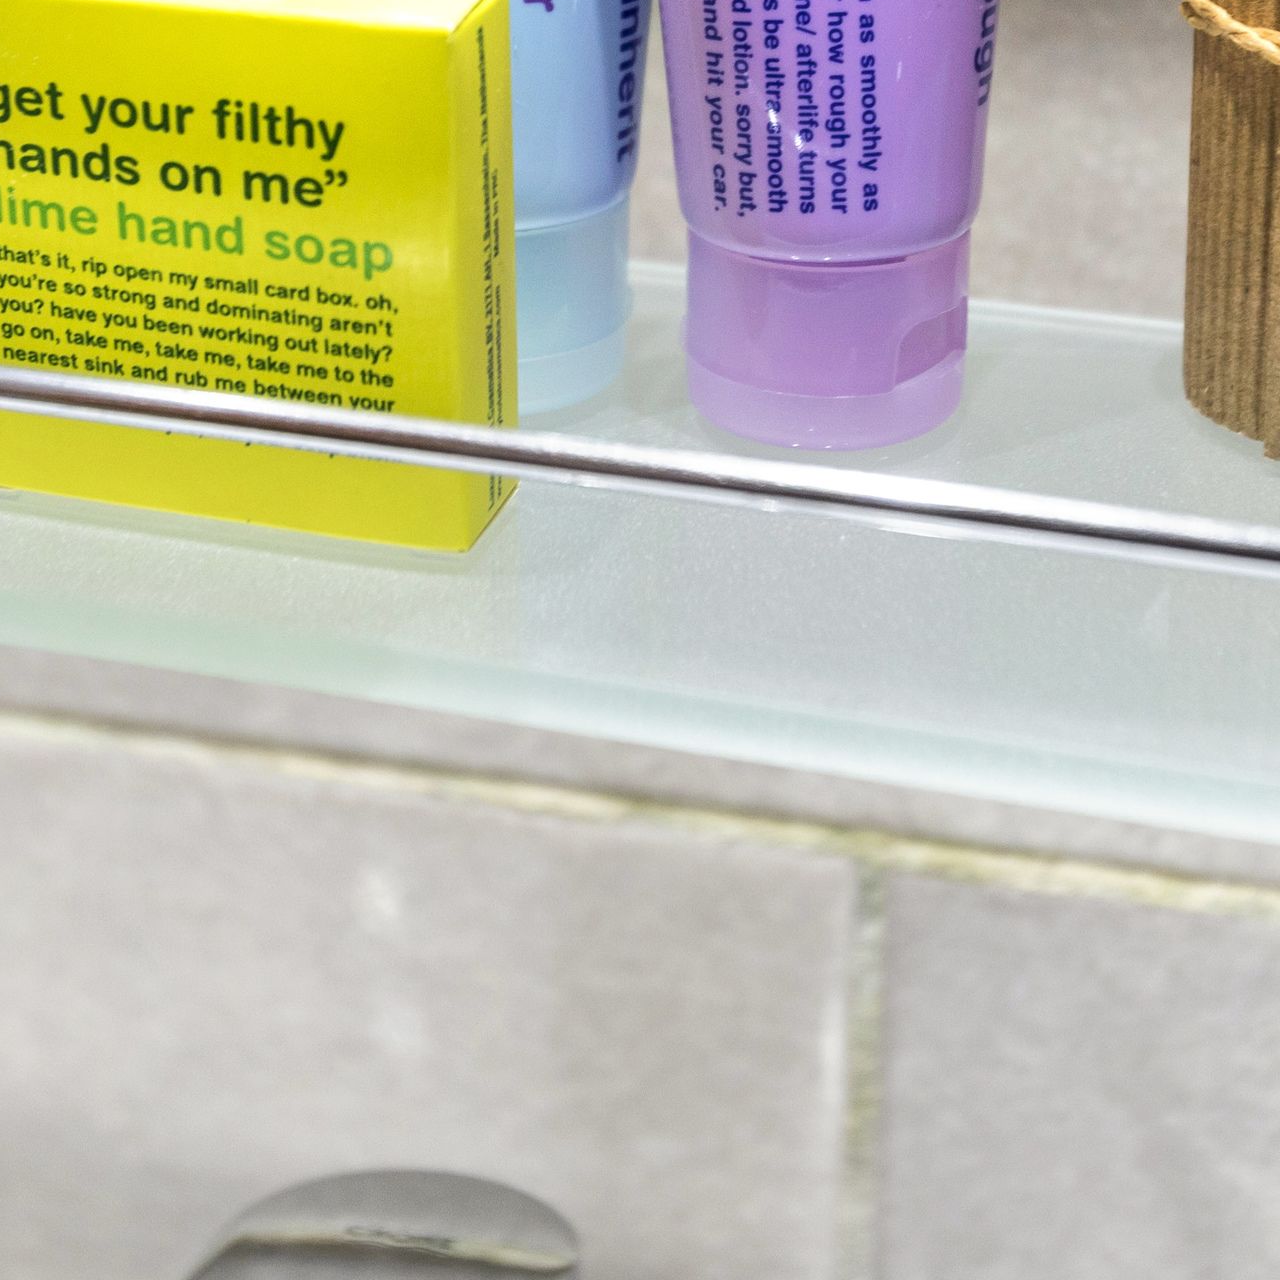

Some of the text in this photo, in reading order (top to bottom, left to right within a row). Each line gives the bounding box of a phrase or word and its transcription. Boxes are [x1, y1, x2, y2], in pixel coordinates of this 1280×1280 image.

[763, 19, 784, 49] be
[827, 11, 848, 64] how
[859, 14, 875, 43] as
[706, 52, 724, 86] hit
[732, 21, 753, 96] lotion.
[796, 43, 819, 143] afterlife
[825, 75, 851, 148] rough
[858, 55, 882, 171] smoothly
[81, 94, 194, 135] your
[212, 99, 344, 161] filthy
[705, 96, 724, 155] your
[733, 104, 752, 165] sorry
[160, 161, 221, 197] on
[713, 164, 727, 211] car.
[738, 172, 757, 217] but,
[799, 151, 817, 214] turns
[826, 158, 847, 214] your
[863, 183, 878, 211] as
[117, 201, 244, 255] hand
[265, 231, 393, 281] soap
[57, 253, 75, 273] it,
[81, 257, 107, 278] rip
[113, 265, 163, 282] open
[169, 272, 198, 291] my
[204, 277, 258, 295] small
[265, 285, 310, 301] card
[316, 287, 358, 307] box.
[366, 295, 398, 314] oh,
[64, 282, 86, 296] so
[92, 285, 156, 310] strong
[163, 296, 200, 312] and
[206, 299, 323, 333] dominating
[0, 298, 393, 365] you? have you been working out lately?
[1, 323, 394, 388] go on, take me, take me, take me to the
[3, 347, 78, 369] nearest
[84, 356, 125, 376] sink
[131, 365, 168, 382] and
[175, 371, 208, 388] rub
[215, 378, 246, 393] me
